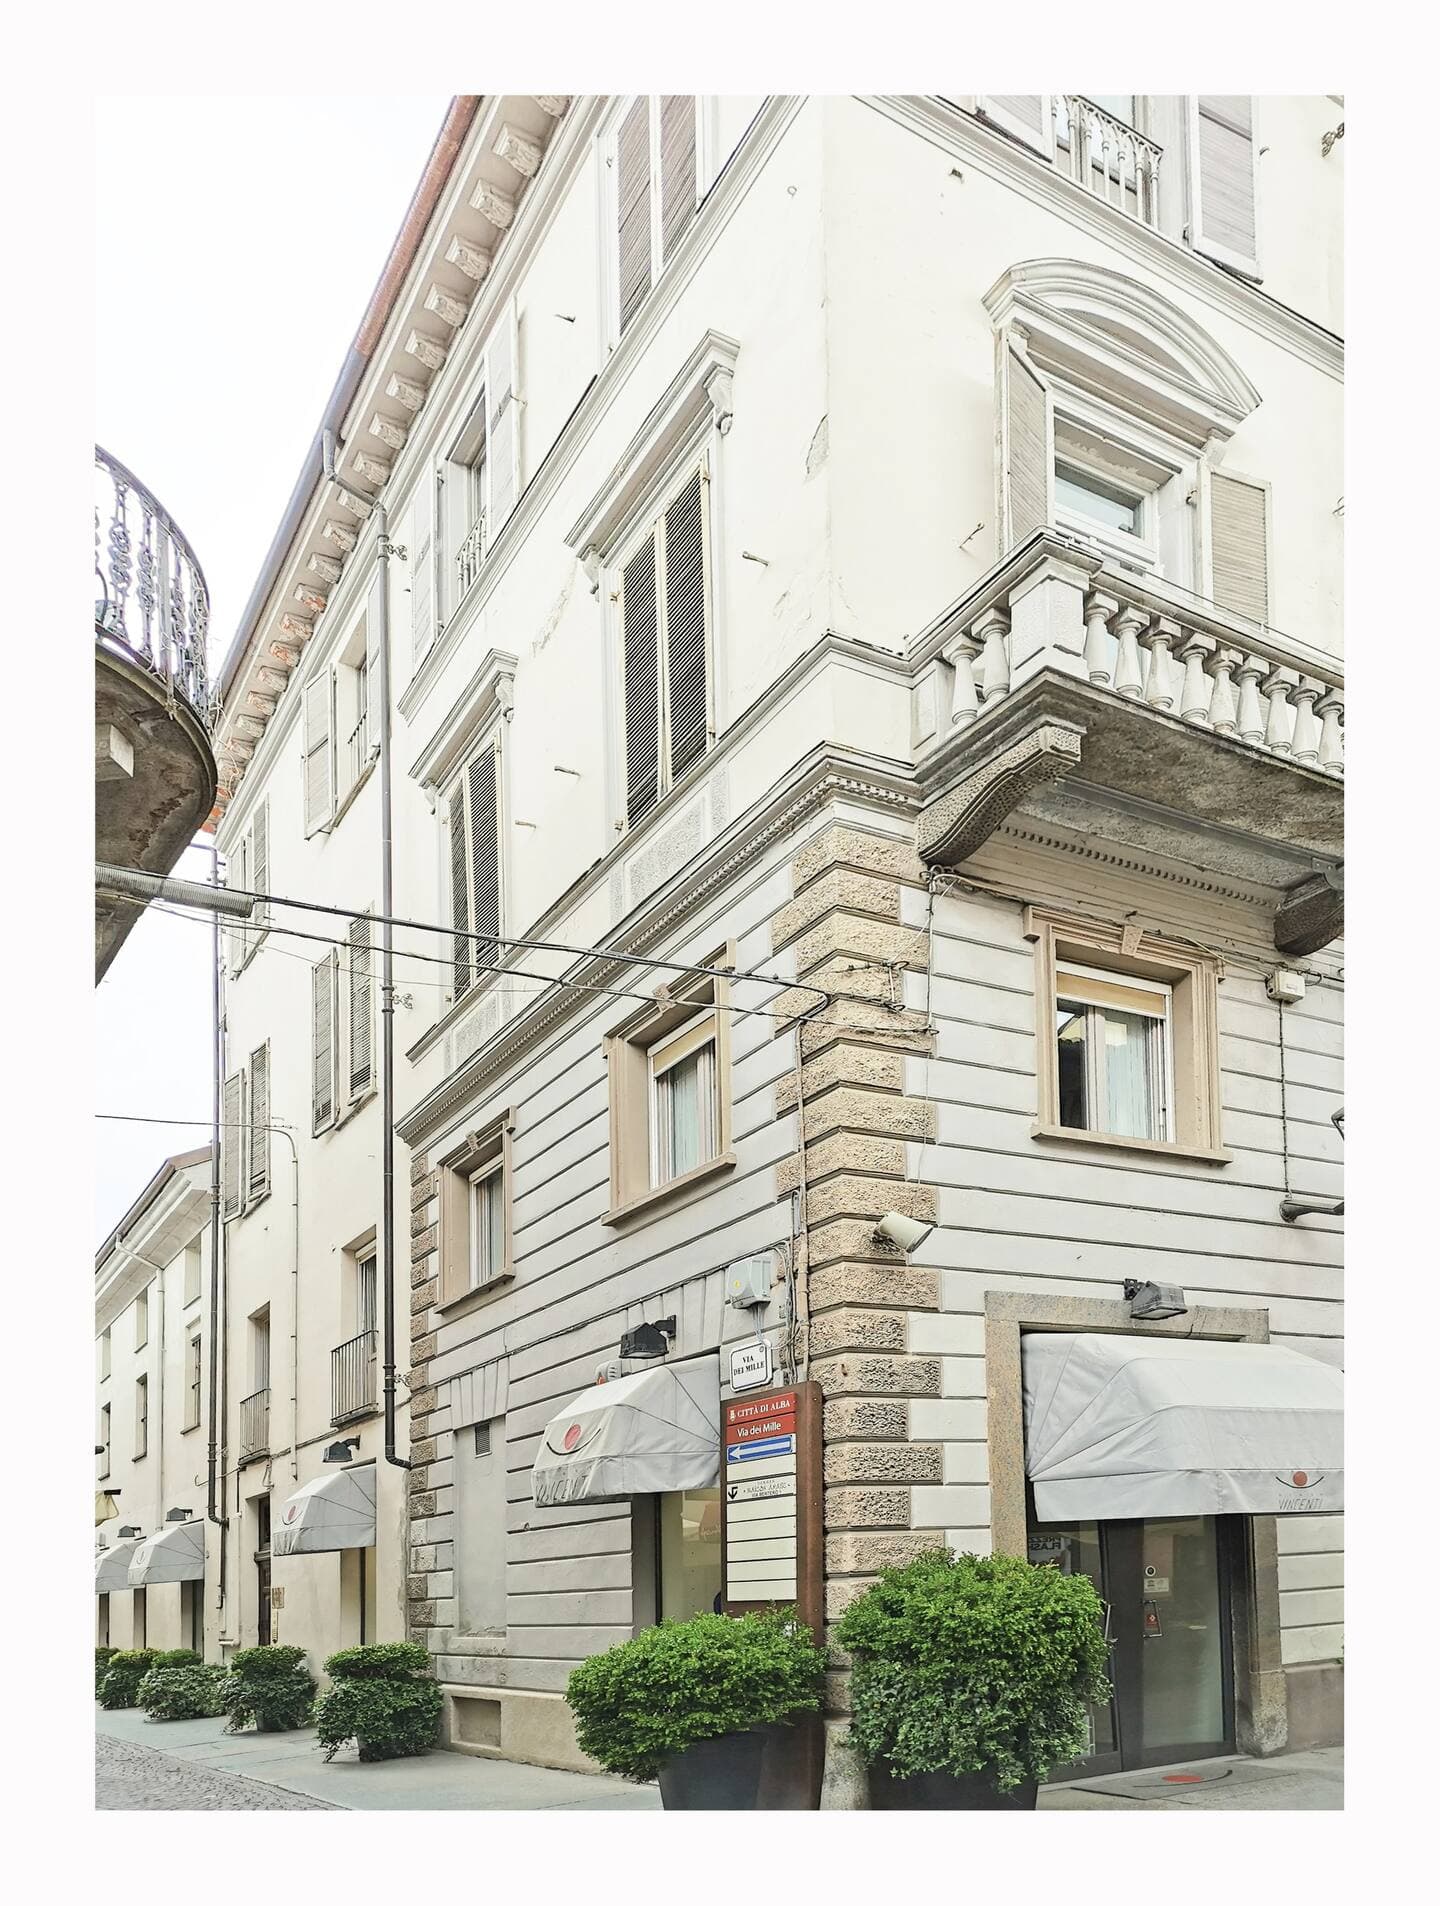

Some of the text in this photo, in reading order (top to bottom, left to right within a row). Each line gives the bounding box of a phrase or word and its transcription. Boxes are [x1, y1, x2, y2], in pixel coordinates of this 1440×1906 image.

[742, 1354, 754, 1363] VIA
[733, 1361, 764, 1376] DEI MILLE
[737, 1399, 791, 1418] CITTÀ DI ALBA
[737, 1421, 782, 1437] Via dei Mille
[1278, 1498, 1324, 1510] VINCENTI
